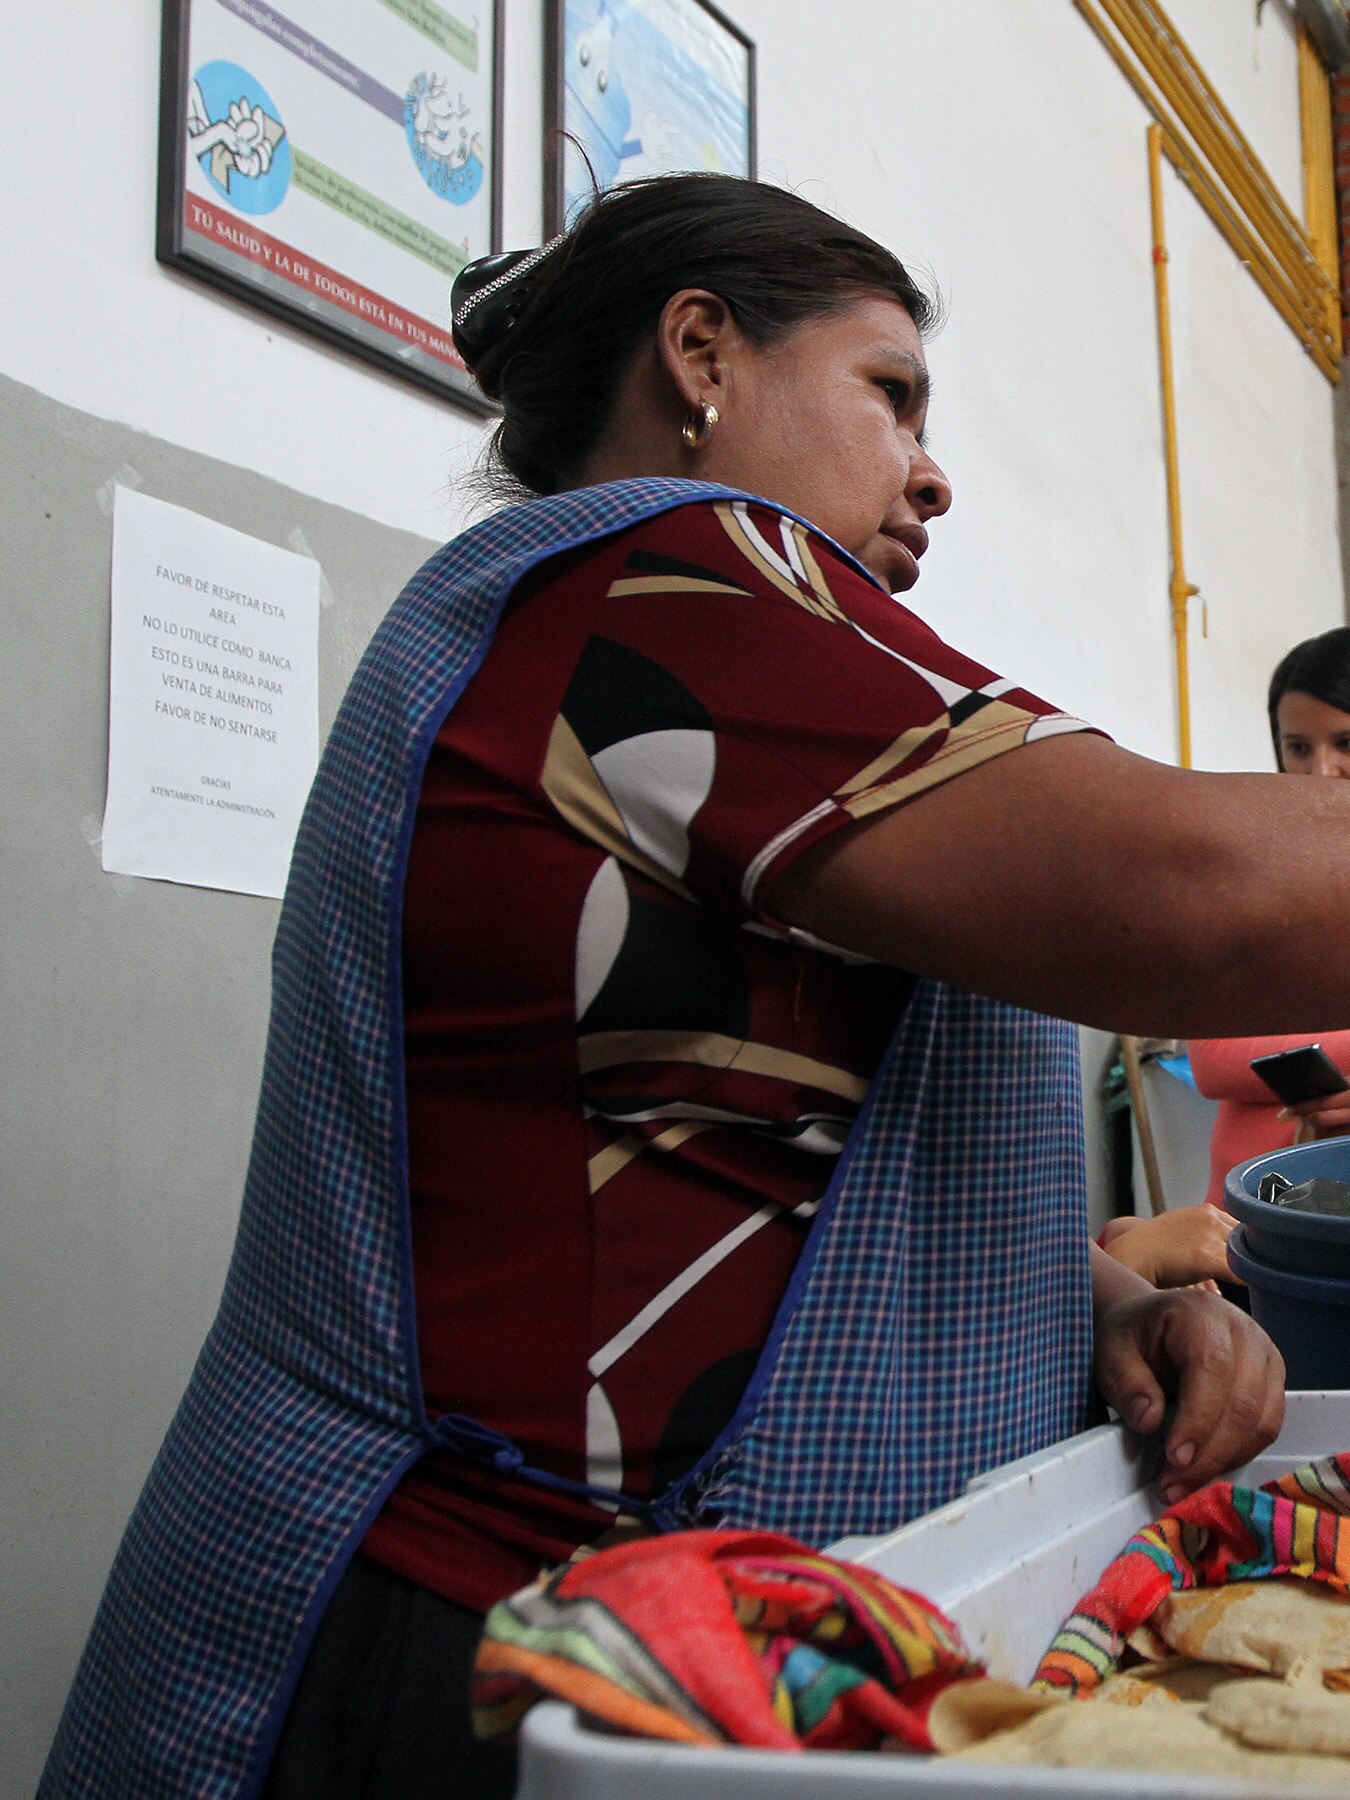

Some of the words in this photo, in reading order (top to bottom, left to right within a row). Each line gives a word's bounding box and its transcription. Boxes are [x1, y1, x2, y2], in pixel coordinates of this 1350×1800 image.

[192, 204, 214, 229] TÚ
[216, 220, 262, 255] SALUD
[263, 244, 273, 261] Y
[275, 252, 291, 272] LA
[293, 261, 310, 282] DE
[314, 272, 356, 306] TODOS
[359, 297, 387, 323] ESTÁ
[388, 313, 404, 331] EN
[406, 322, 427, 344] TUS
[156, 565, 192, 587] FAVOR
[195, 578, 210, 593] DE
[212, 584, 260, 611] RESPETAR
[262, 602, 286, 620] ESTA
[209, 607, 236, 626] AREA
[143, 615, 161, 630] NO
[164, 621, 178, 635] LO
[180, 626, 219, 648] UTILICE
[221, 639, 254, 659] COMO
[258, 650, 291, 670] BANCA
[152, 646, 179, 665] ESTO
[182, 655, 194, 669] ES
[196, 660, 219, 676] UNA
[222, 667, 255, 687] BARRA
[257, 678, 283, 695] PARA
[162, 673, 197, 694] VENTA
[199, 684, 213, 698] DE
[215, 689, 273, 715] ALIMENTOS
[155, 700, 191, 721] FAVOR
[193, 711, 207, 725] DE
[209, 715, 226, 730] NO
[228, 719, 278, 743] SENTARSE
[150, 786, 204, 805] ATENTAMENTE
[205, 798, 214, 806] LA
[200, 776, 231, 790] GRACIAS
